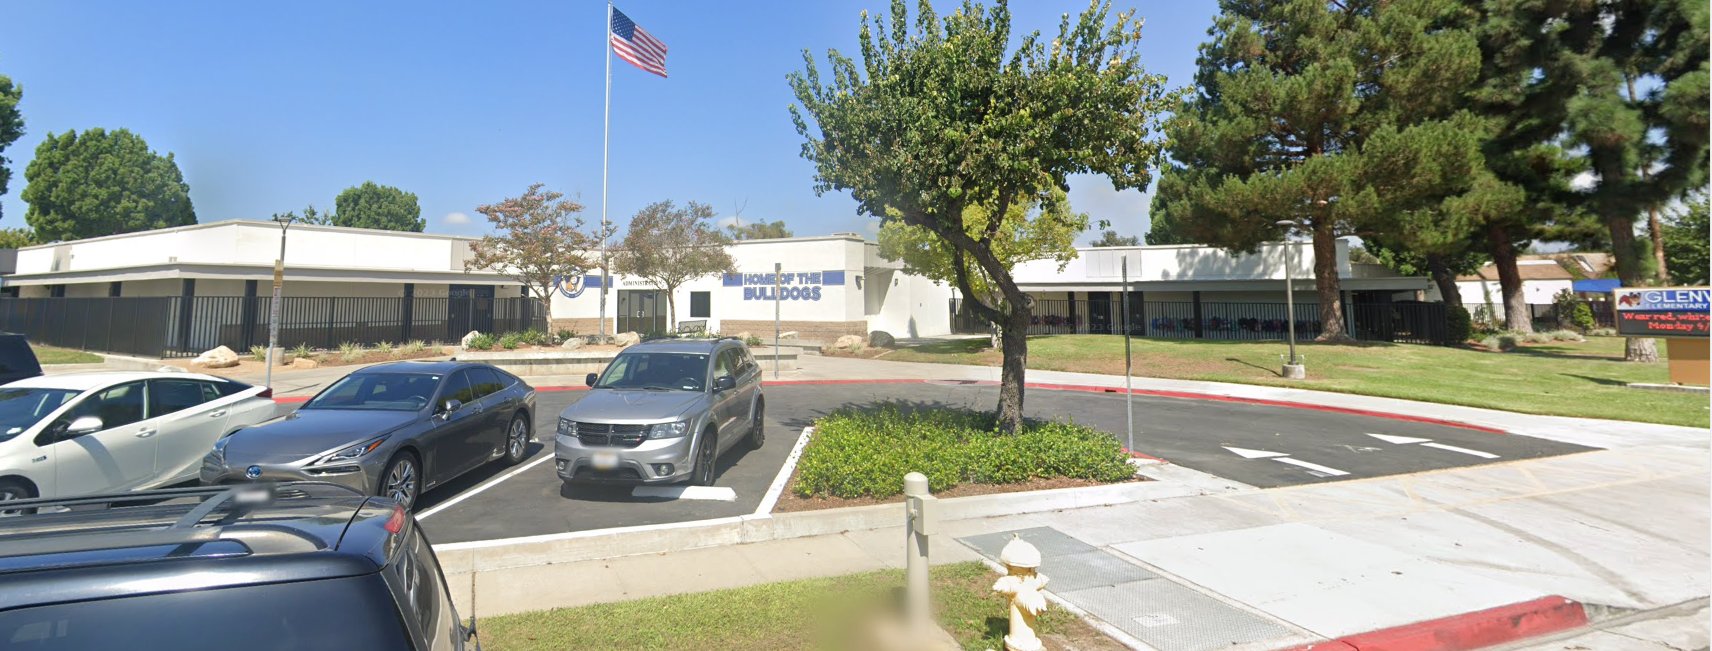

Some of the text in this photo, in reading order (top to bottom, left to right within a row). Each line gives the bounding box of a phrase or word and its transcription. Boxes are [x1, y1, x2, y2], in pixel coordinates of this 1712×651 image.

[744, 272, 821, 285] HOME OF THE
[744, 286, 821, 301] BULLDOGS
[1648, 322, 1694, 331] Monday
